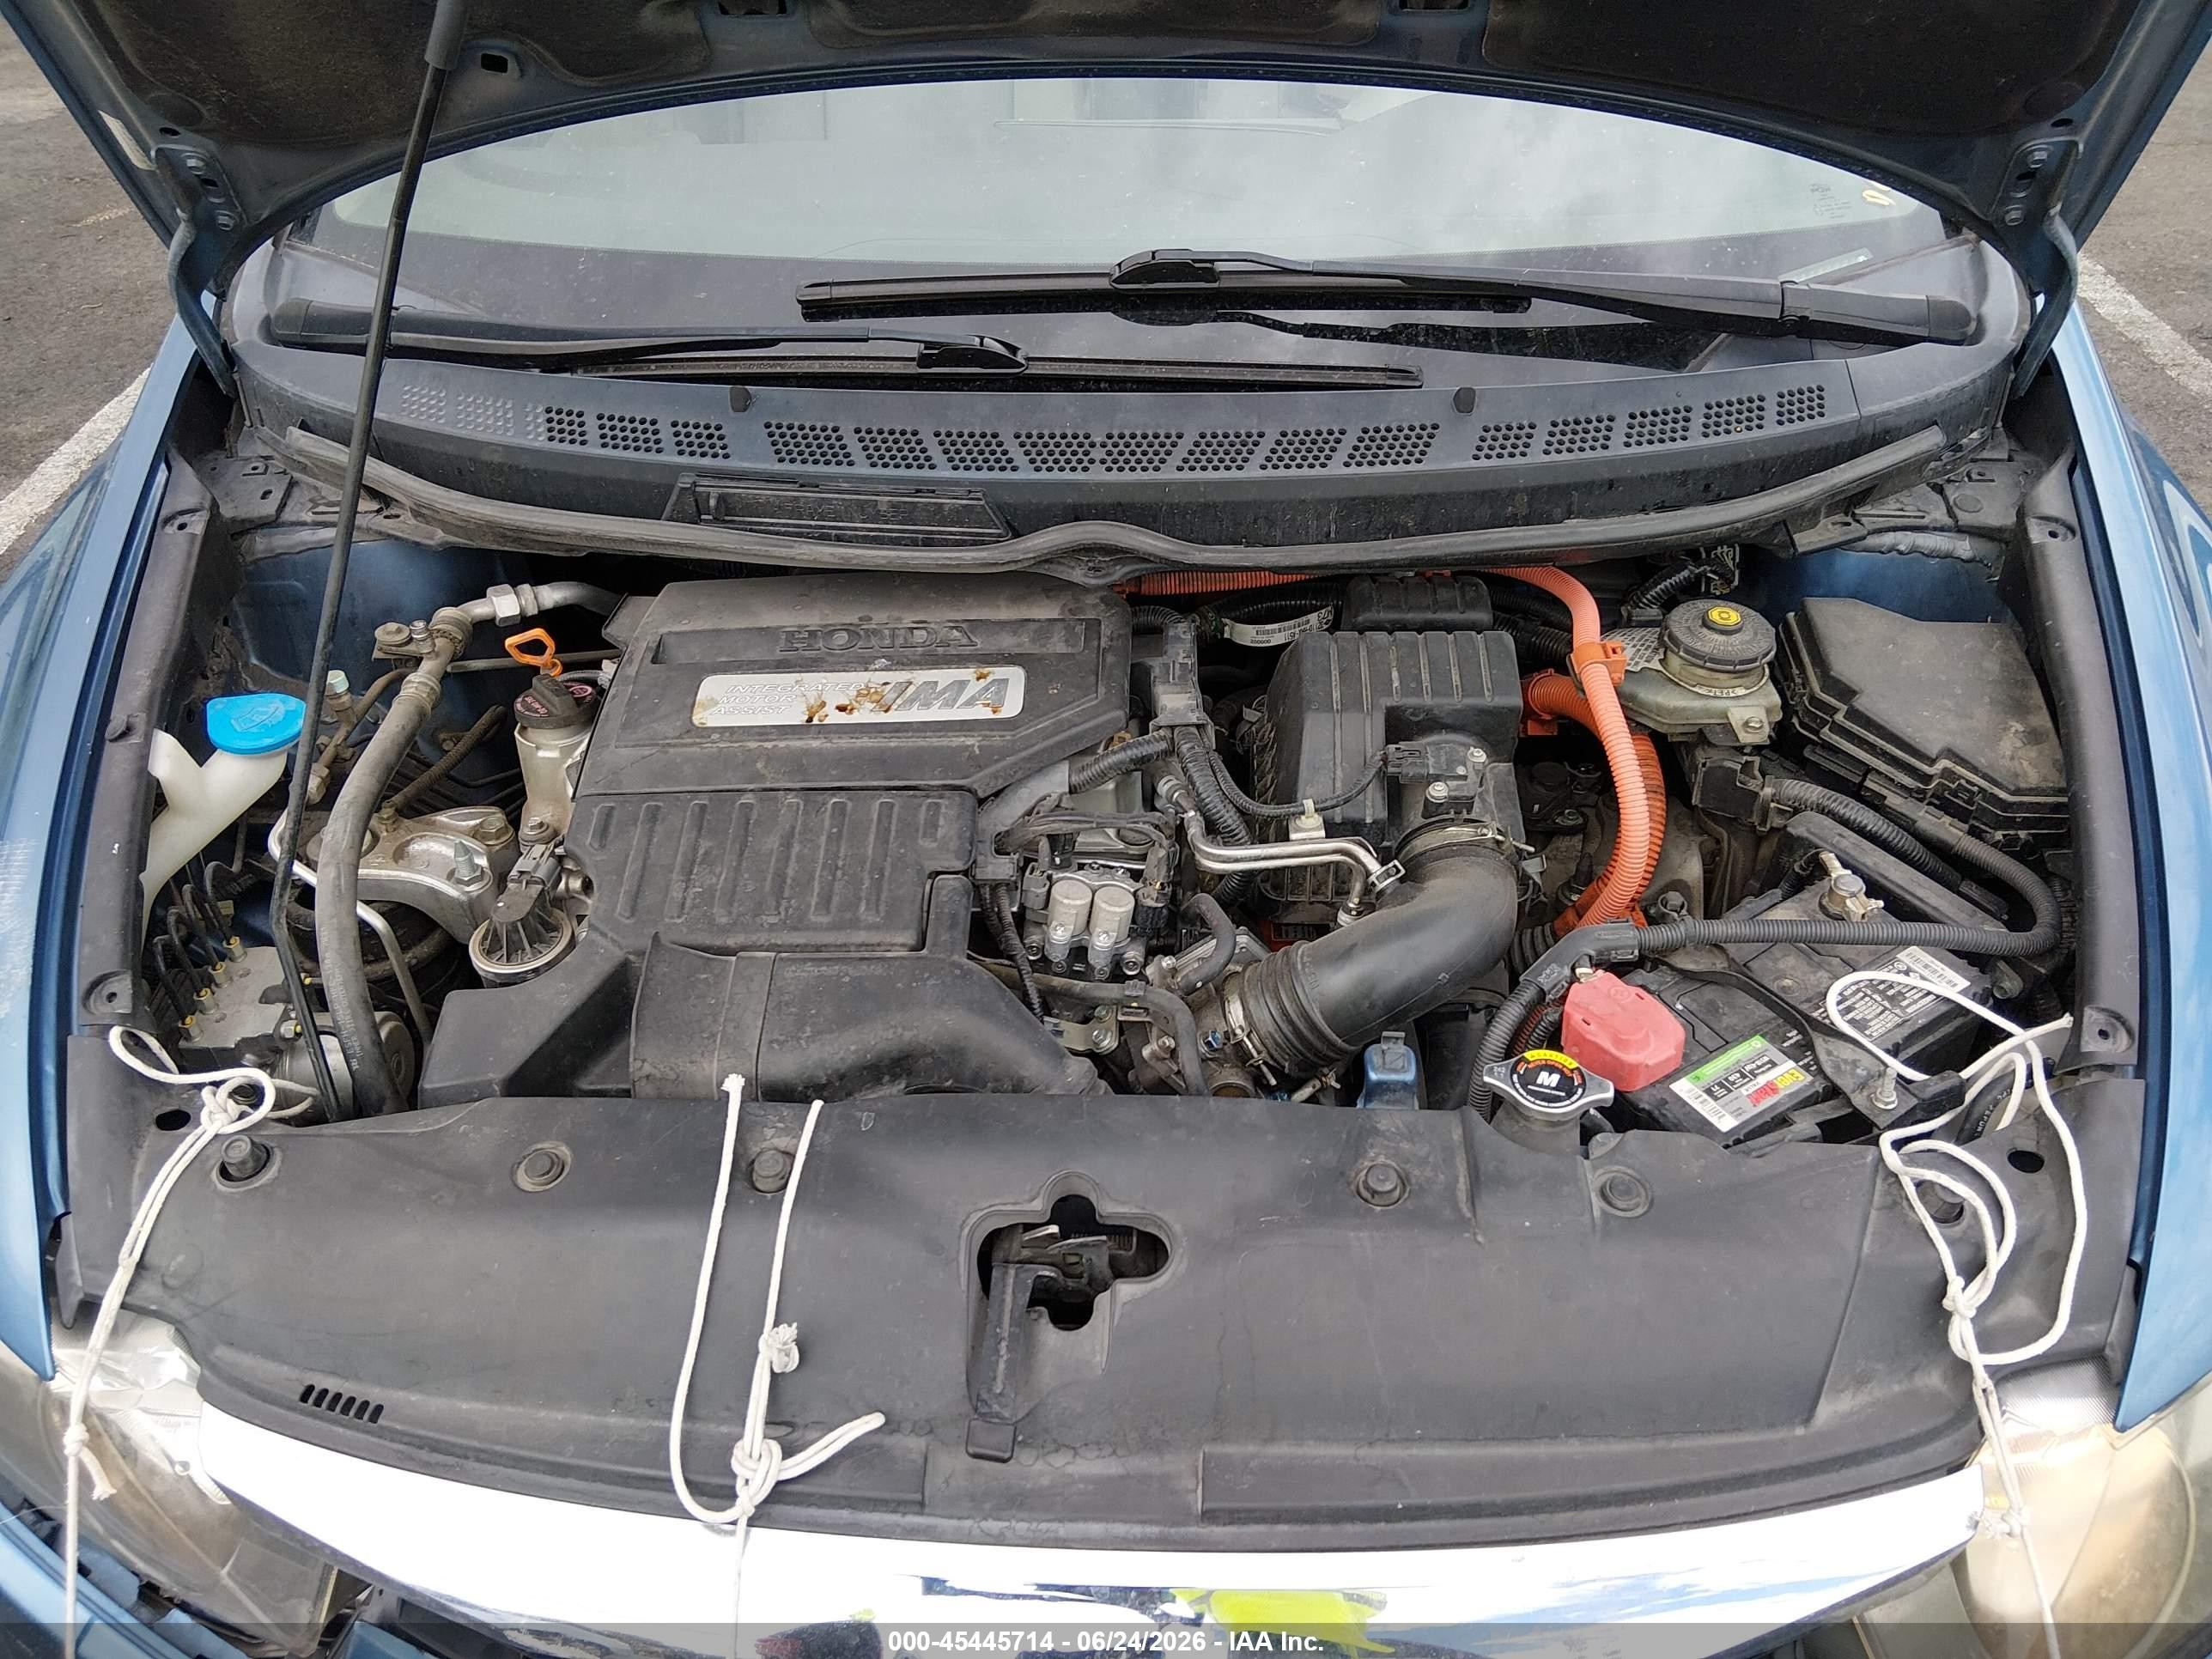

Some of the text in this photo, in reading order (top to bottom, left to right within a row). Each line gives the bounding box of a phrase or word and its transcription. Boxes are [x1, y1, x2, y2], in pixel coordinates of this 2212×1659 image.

[779, 625, 979, 653] HONDA
[726, 682, 865, 694] INTEGRATED
[871, 678, 1011, 713] IMA
[718, 694, 798, 705] MOTOR
[709, 705, 792, 716] ASSIST
[1536, 1071, 1561, 1088] M
[1745, 1067, 1805, 1107] EverStart
